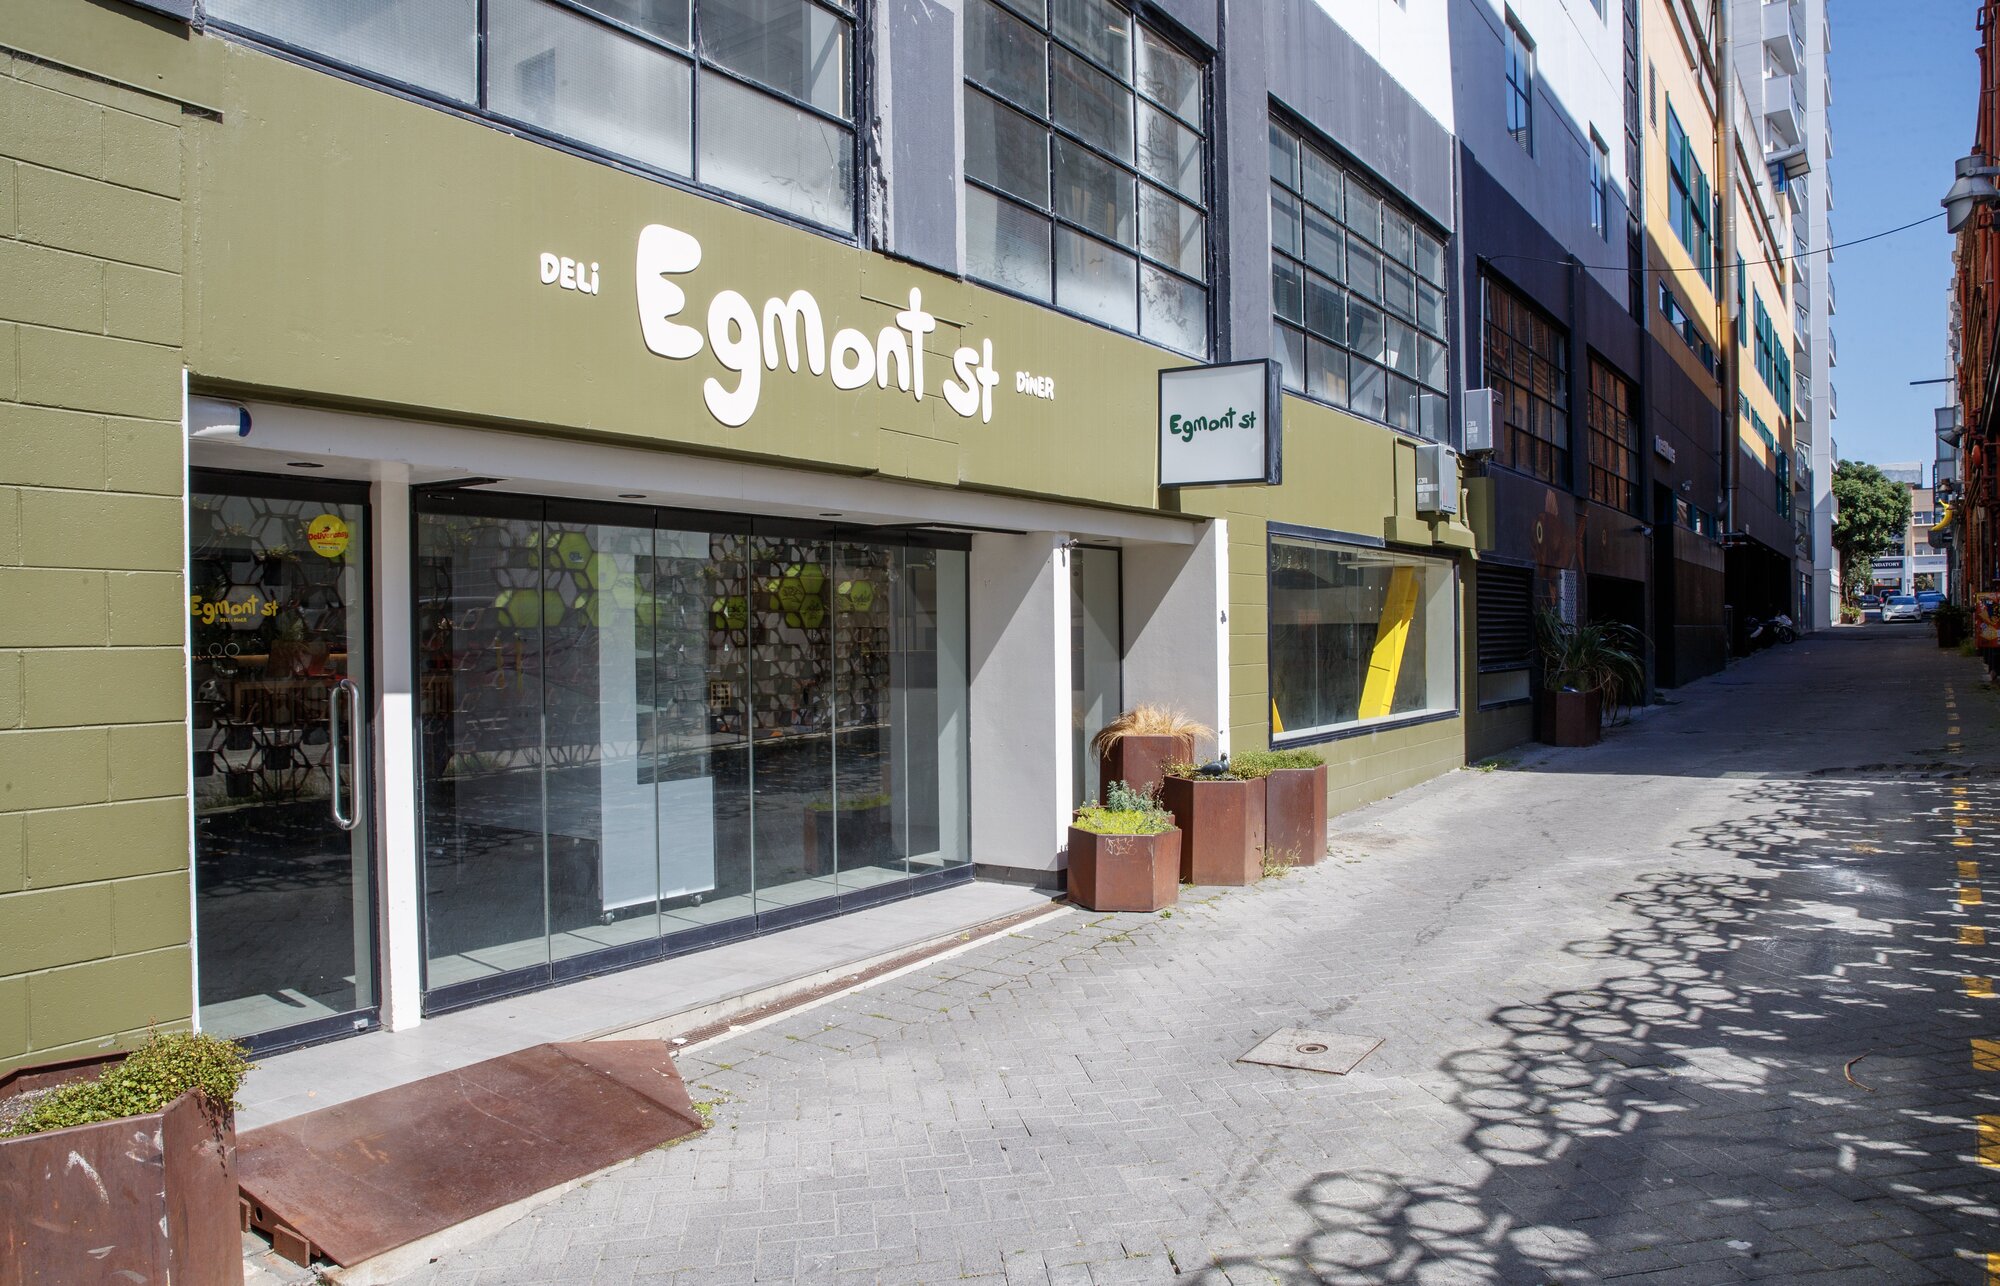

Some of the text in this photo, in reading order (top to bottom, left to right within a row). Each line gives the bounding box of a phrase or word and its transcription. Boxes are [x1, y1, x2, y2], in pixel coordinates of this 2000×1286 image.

[635, 223, 936, 426] Egmont
[942, 337, 1000, 424] st
[1169, 407, 1257, 443] Egmont st
[190, 594, 279, 625] Egmont st
